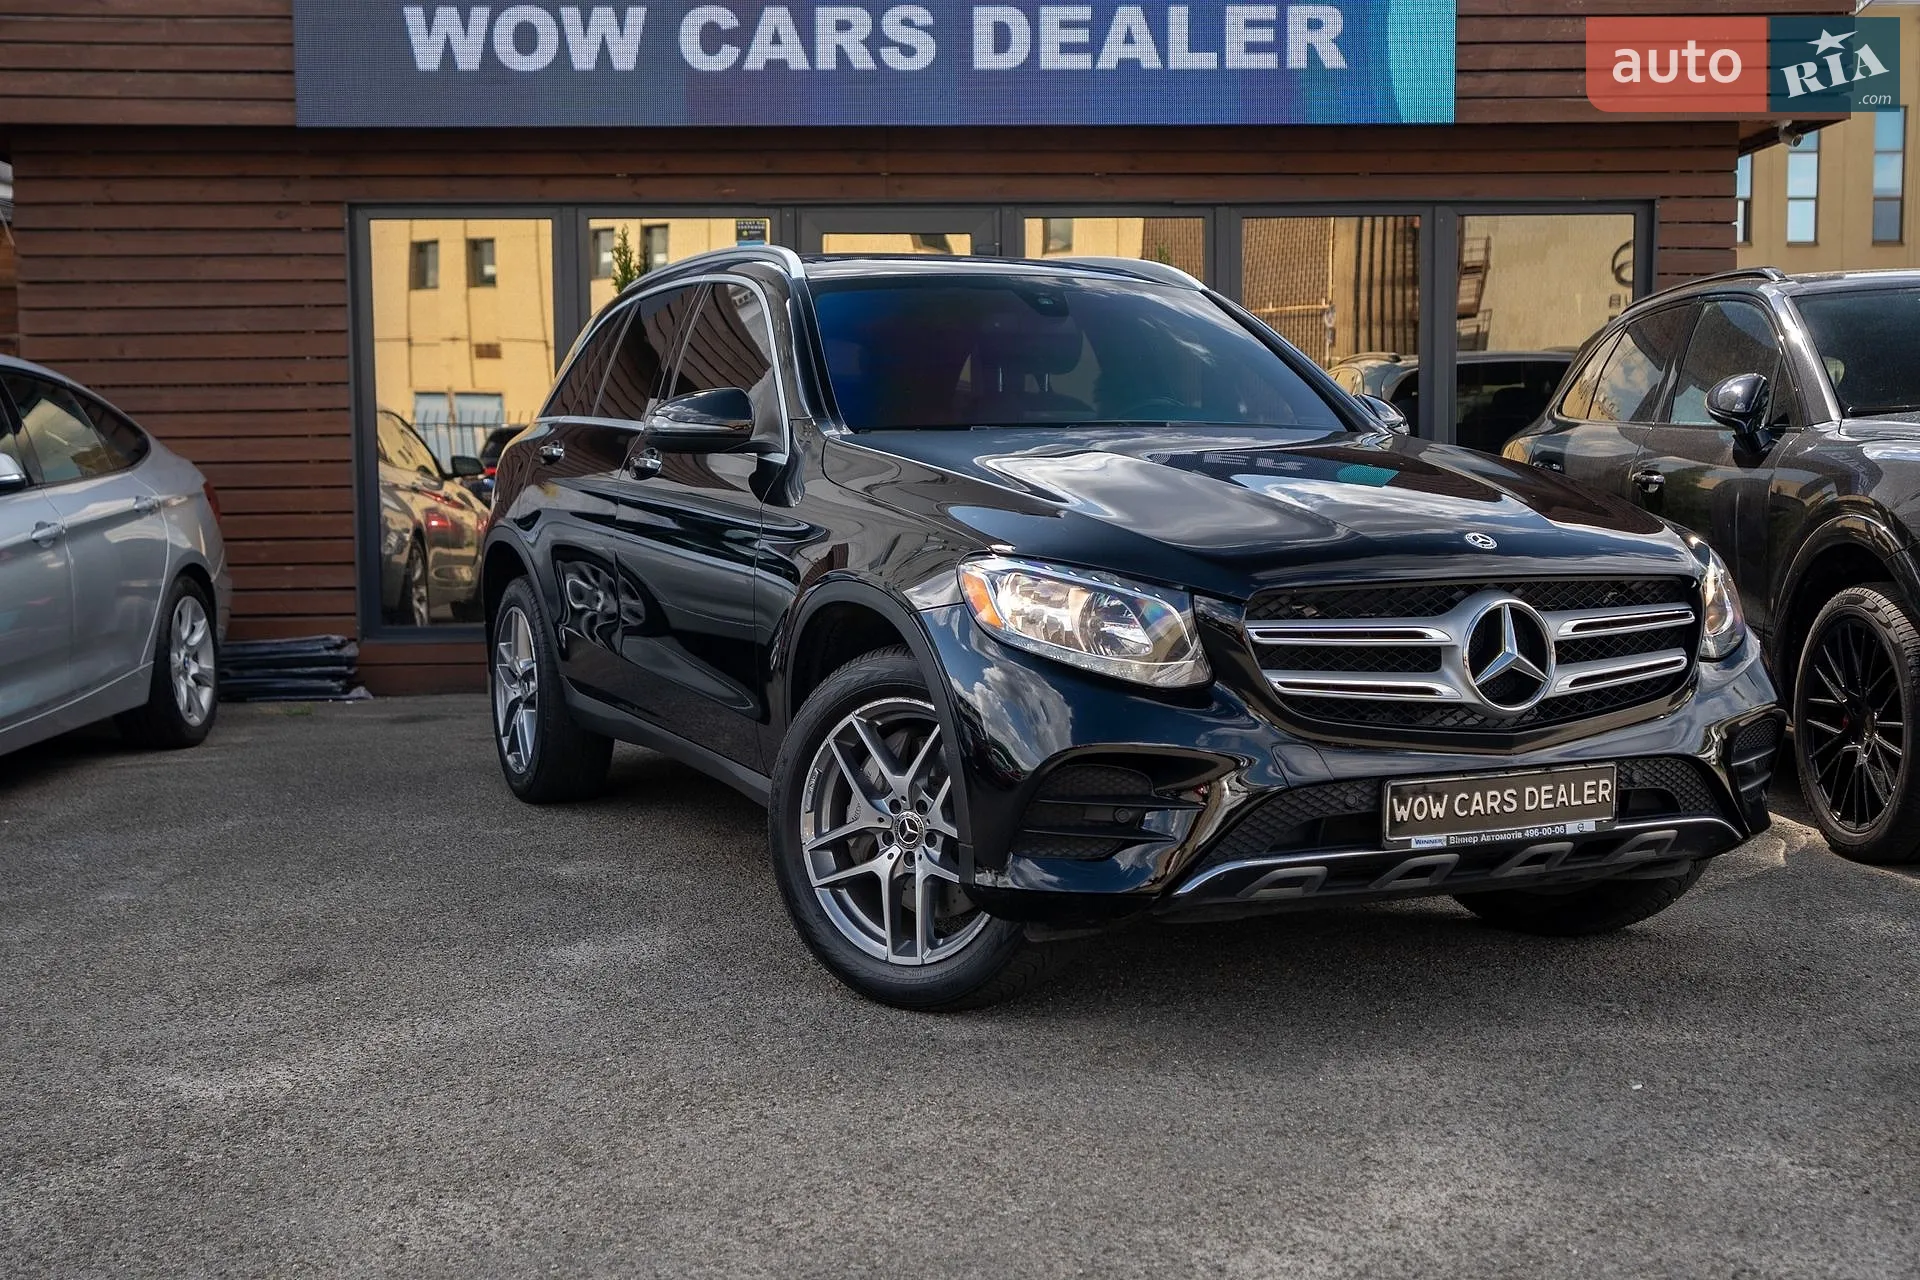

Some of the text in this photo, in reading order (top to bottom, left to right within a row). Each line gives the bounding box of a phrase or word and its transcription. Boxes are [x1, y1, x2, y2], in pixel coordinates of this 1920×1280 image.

[402, 4, 1348, 71] WOW CARS DEALER
[1392, 779, 1612, 823] WOW CARS DEALER
